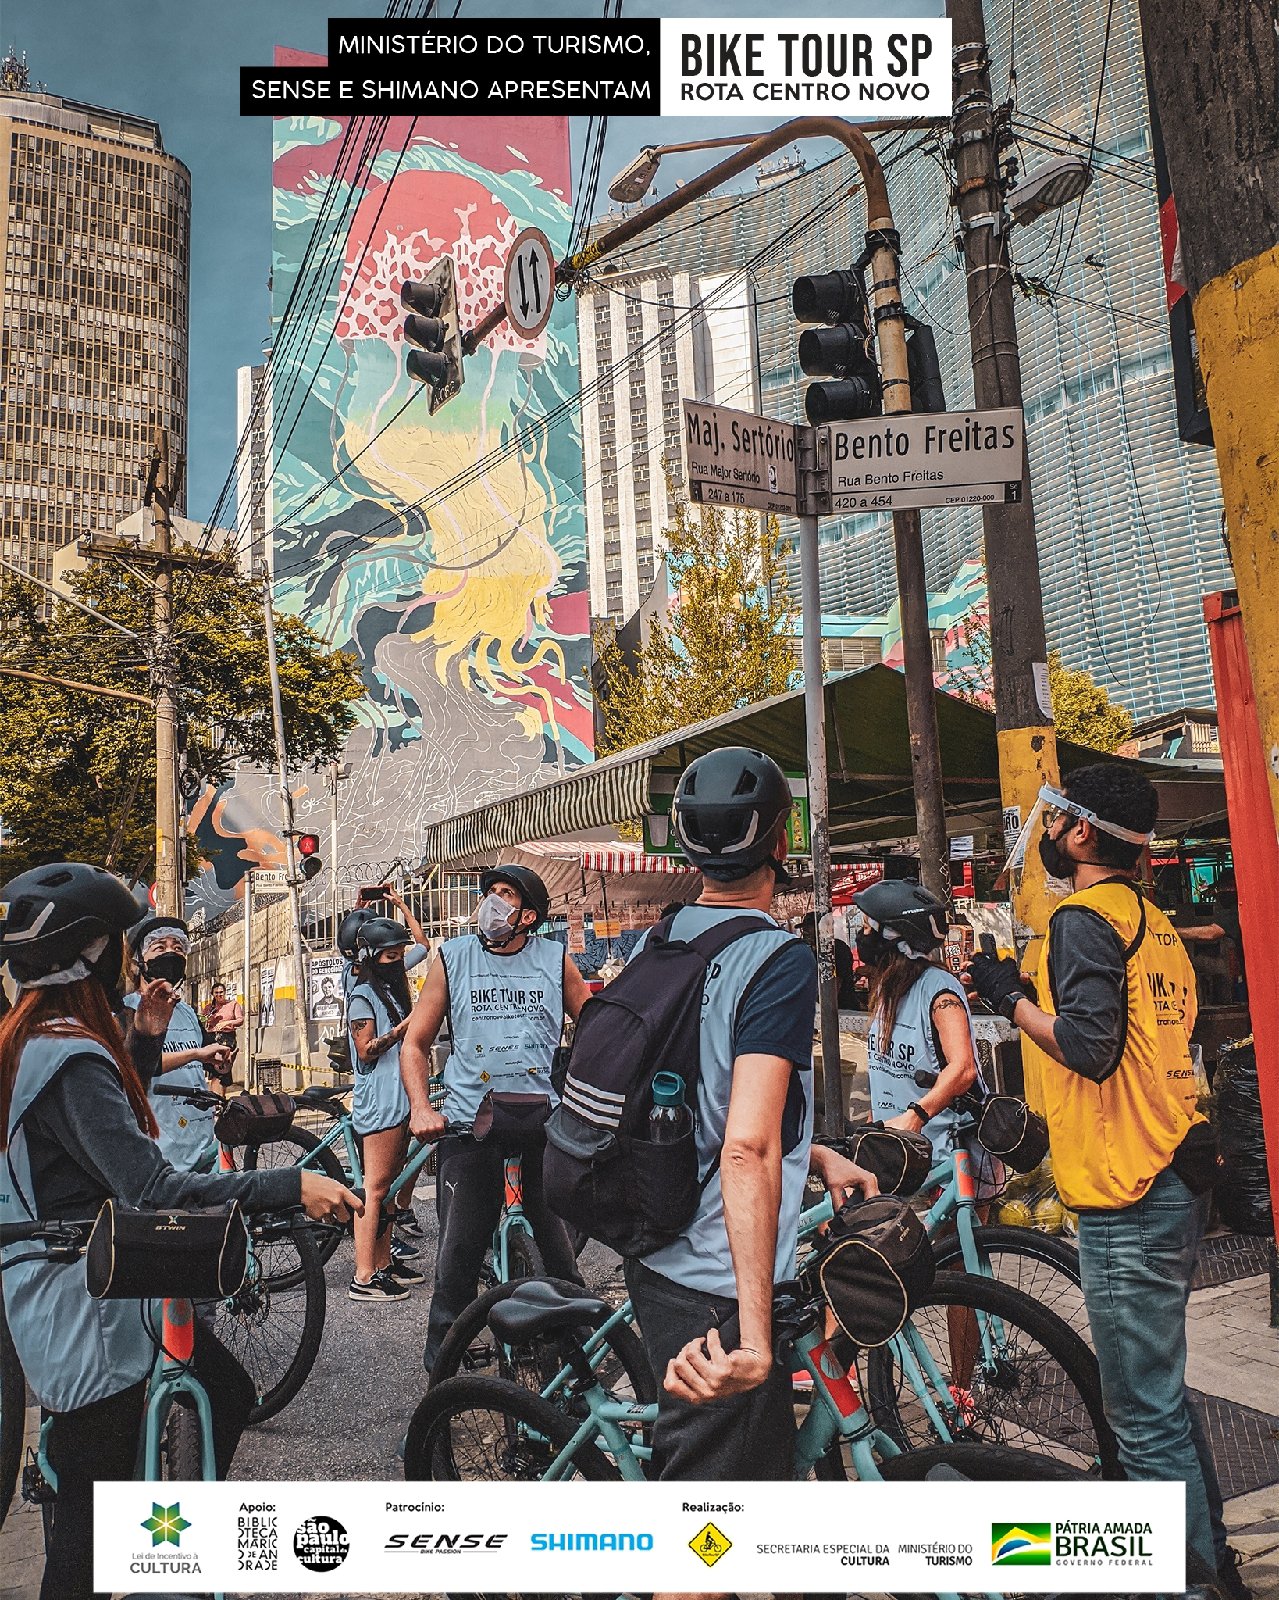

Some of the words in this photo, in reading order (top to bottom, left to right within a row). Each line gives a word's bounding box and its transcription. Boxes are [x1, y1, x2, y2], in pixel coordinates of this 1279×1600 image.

[686, 411, 726, 458] Maj.
[731, 420, 795, 463] Sertório
[834, 432, 909, 461] Bento
[925, 416, 1015, 455] Freitas
[691, 461, 709, 475] Rua
[710, 464, 732, 480] Major
[838, 475, 862, 488] Rua
[865, 472, 900, 484] Bento
[903, 469, 944, 481] Freitas
[708, 487, 723, 500] 247
[724, 493, 731, 503] a
[834, 497, 857, 508] 420
[861, 499, 870, 507] a
[872, 494, 893, 507] 454
[1011, 490, 1017, 501] 1
[255, 872, 276, 881] Bento
[470, 988, 498, 1004] BIKE
[529, 991, 544, 1004] SP
[471, 1004, 493, 1013] ROTA
[898, 1043, 915, 1063] SP
